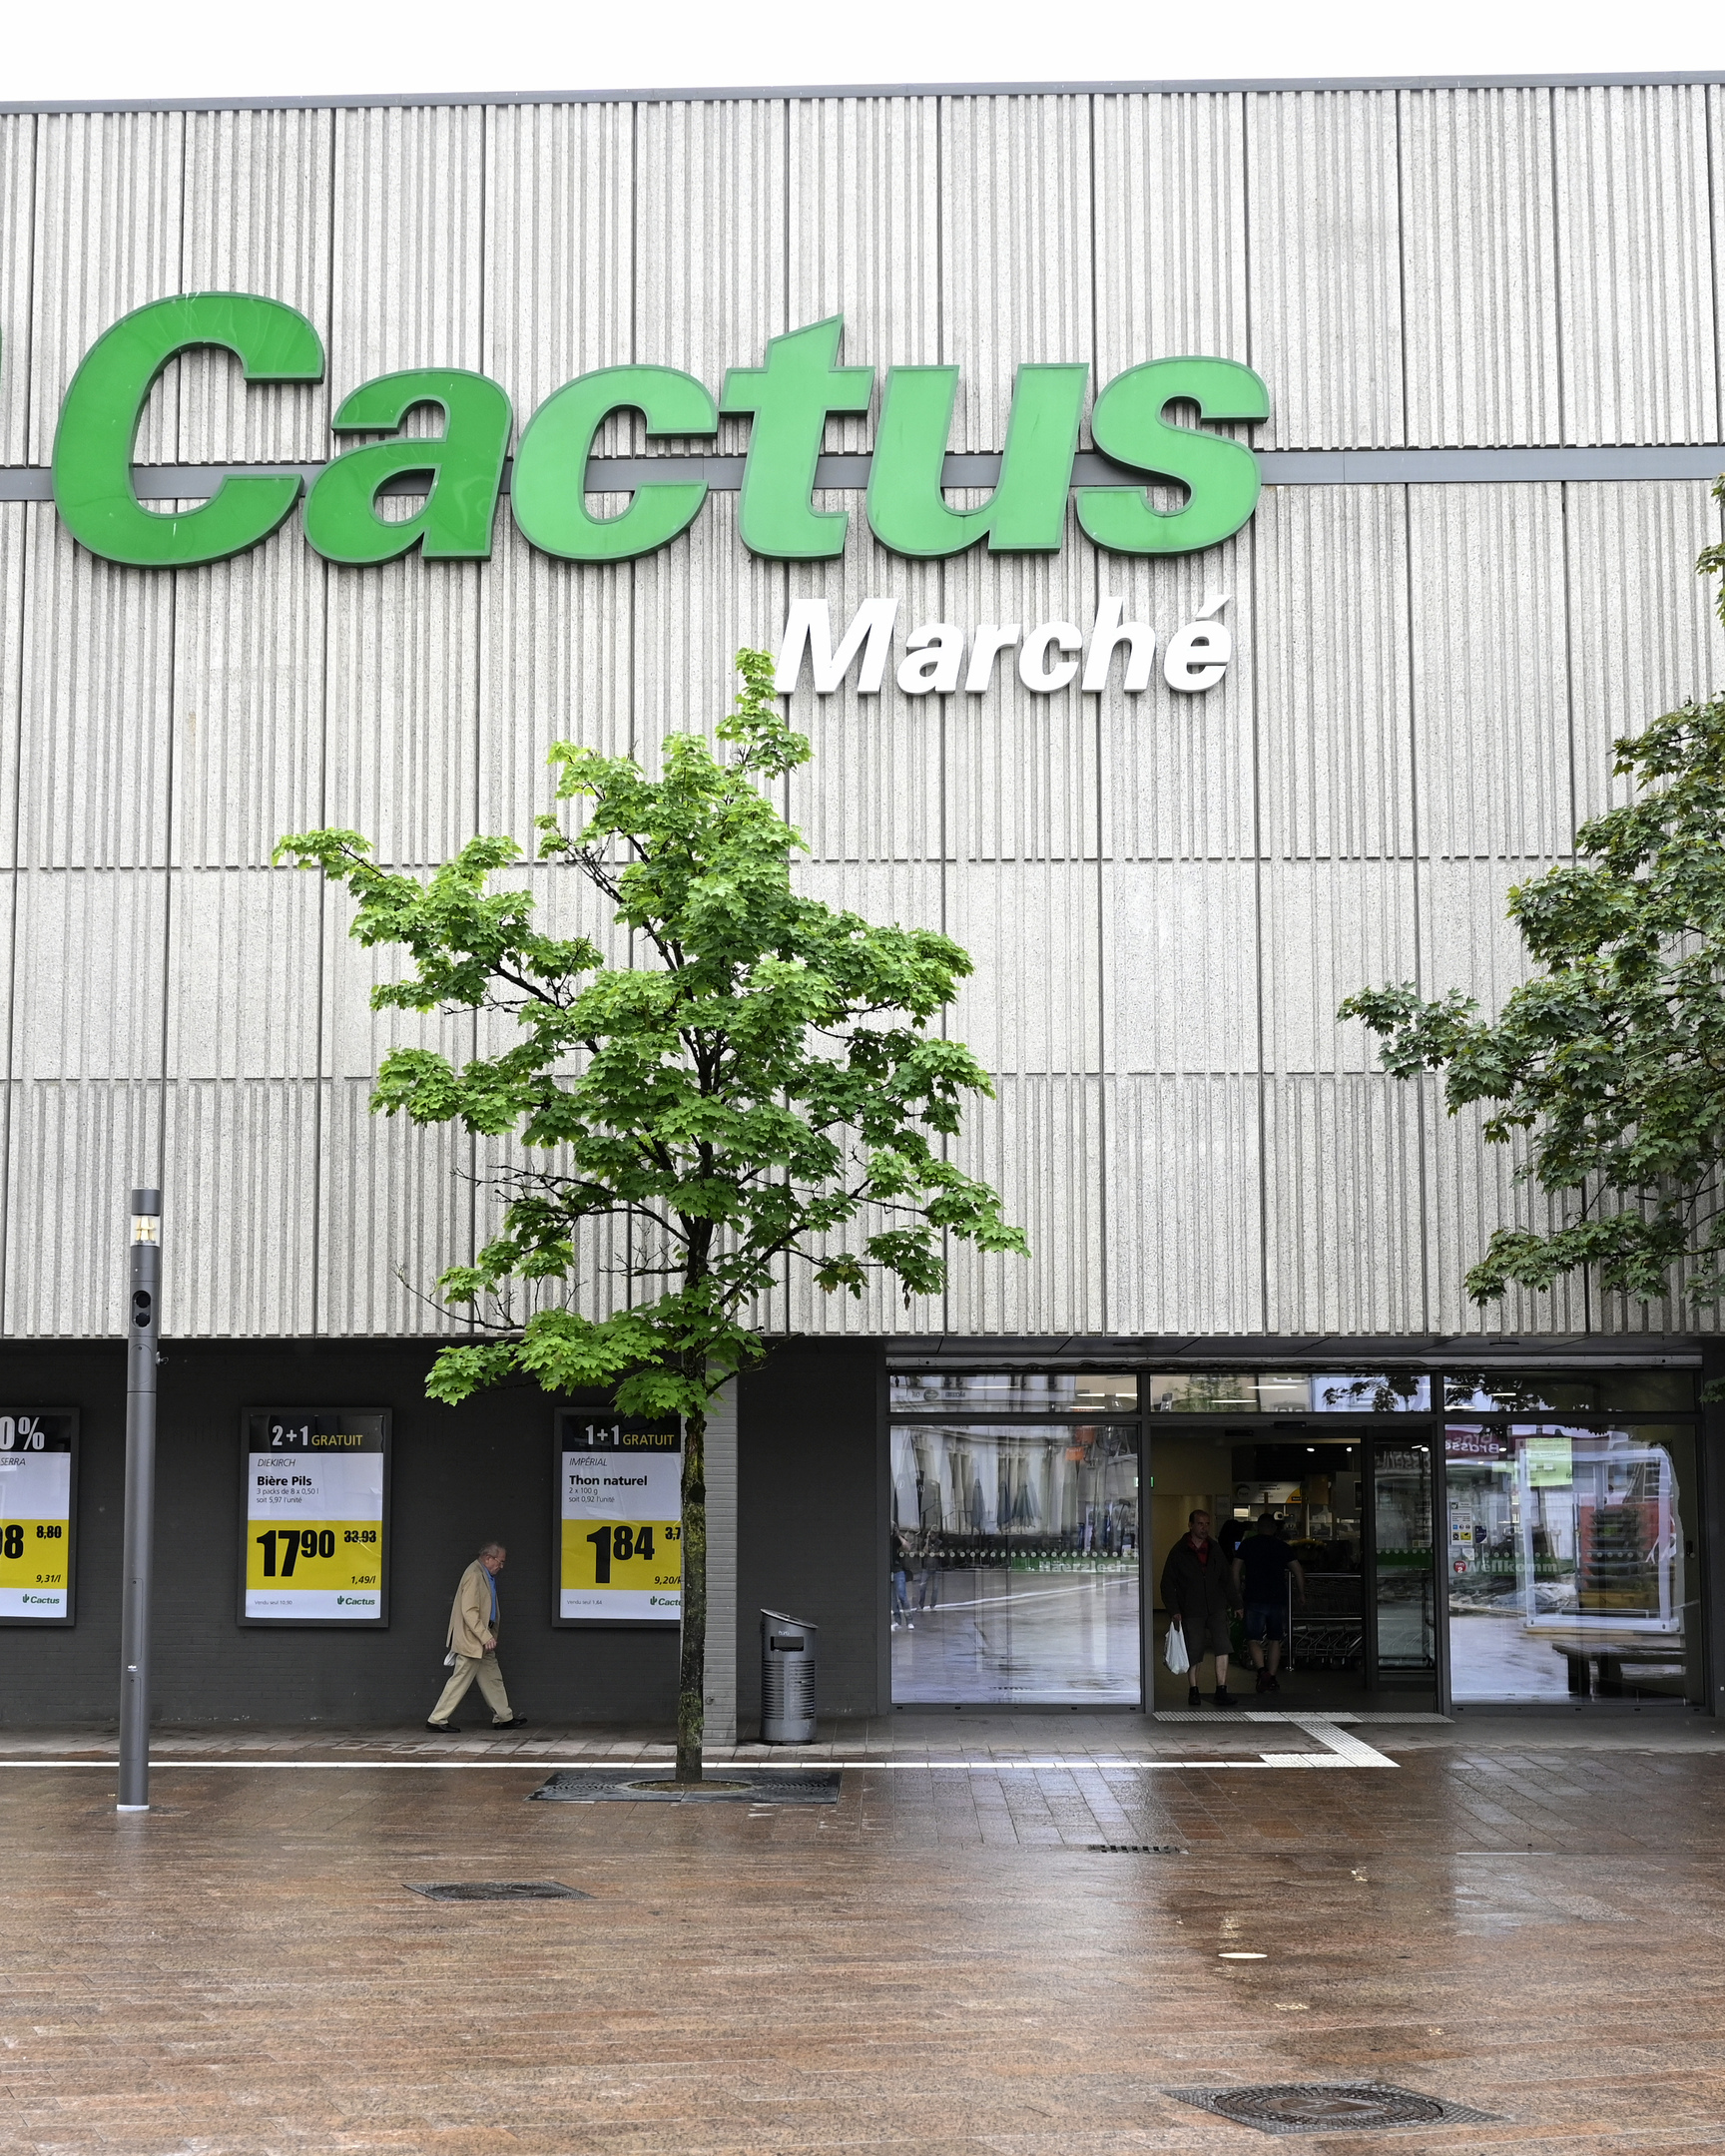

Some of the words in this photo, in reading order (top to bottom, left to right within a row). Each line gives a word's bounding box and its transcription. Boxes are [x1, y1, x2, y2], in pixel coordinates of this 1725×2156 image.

[51, 290, 1270, 568] Cactus
[775, 594, 1233, 695] Marché
[311, 1434, 363, 1446] GRATUIT
[622, 1434, 675, 1445] GRATUIT
[257, 1458, 296, 1467] DIEKIRCH
[569, 1456, 608, 1467] IMPÉRIAL
[257, 1475, 288, 1486] Bière
[291, 1475, 312, 1486] Pils
[569, 1474, 600, 1485] Thon
[603, 1474, 648, 1486] naturel
[262, 1487, 281, 1496] packs
[0, 1524, 24, 1559] 8
[1039, 1560, 1127, 1572] Häerzlech
[1466, 1560, 1557, 1572] Wëllkomm
[350, 1575, 376, 1585] 1,49/l
[654, 1575, 681, 1585] 9,20/k
[30, 1596, 60, 1605] Cactus
[345, 1597, 375, 1606] Cactus
[658, 1597, 681, 1606] Cact
